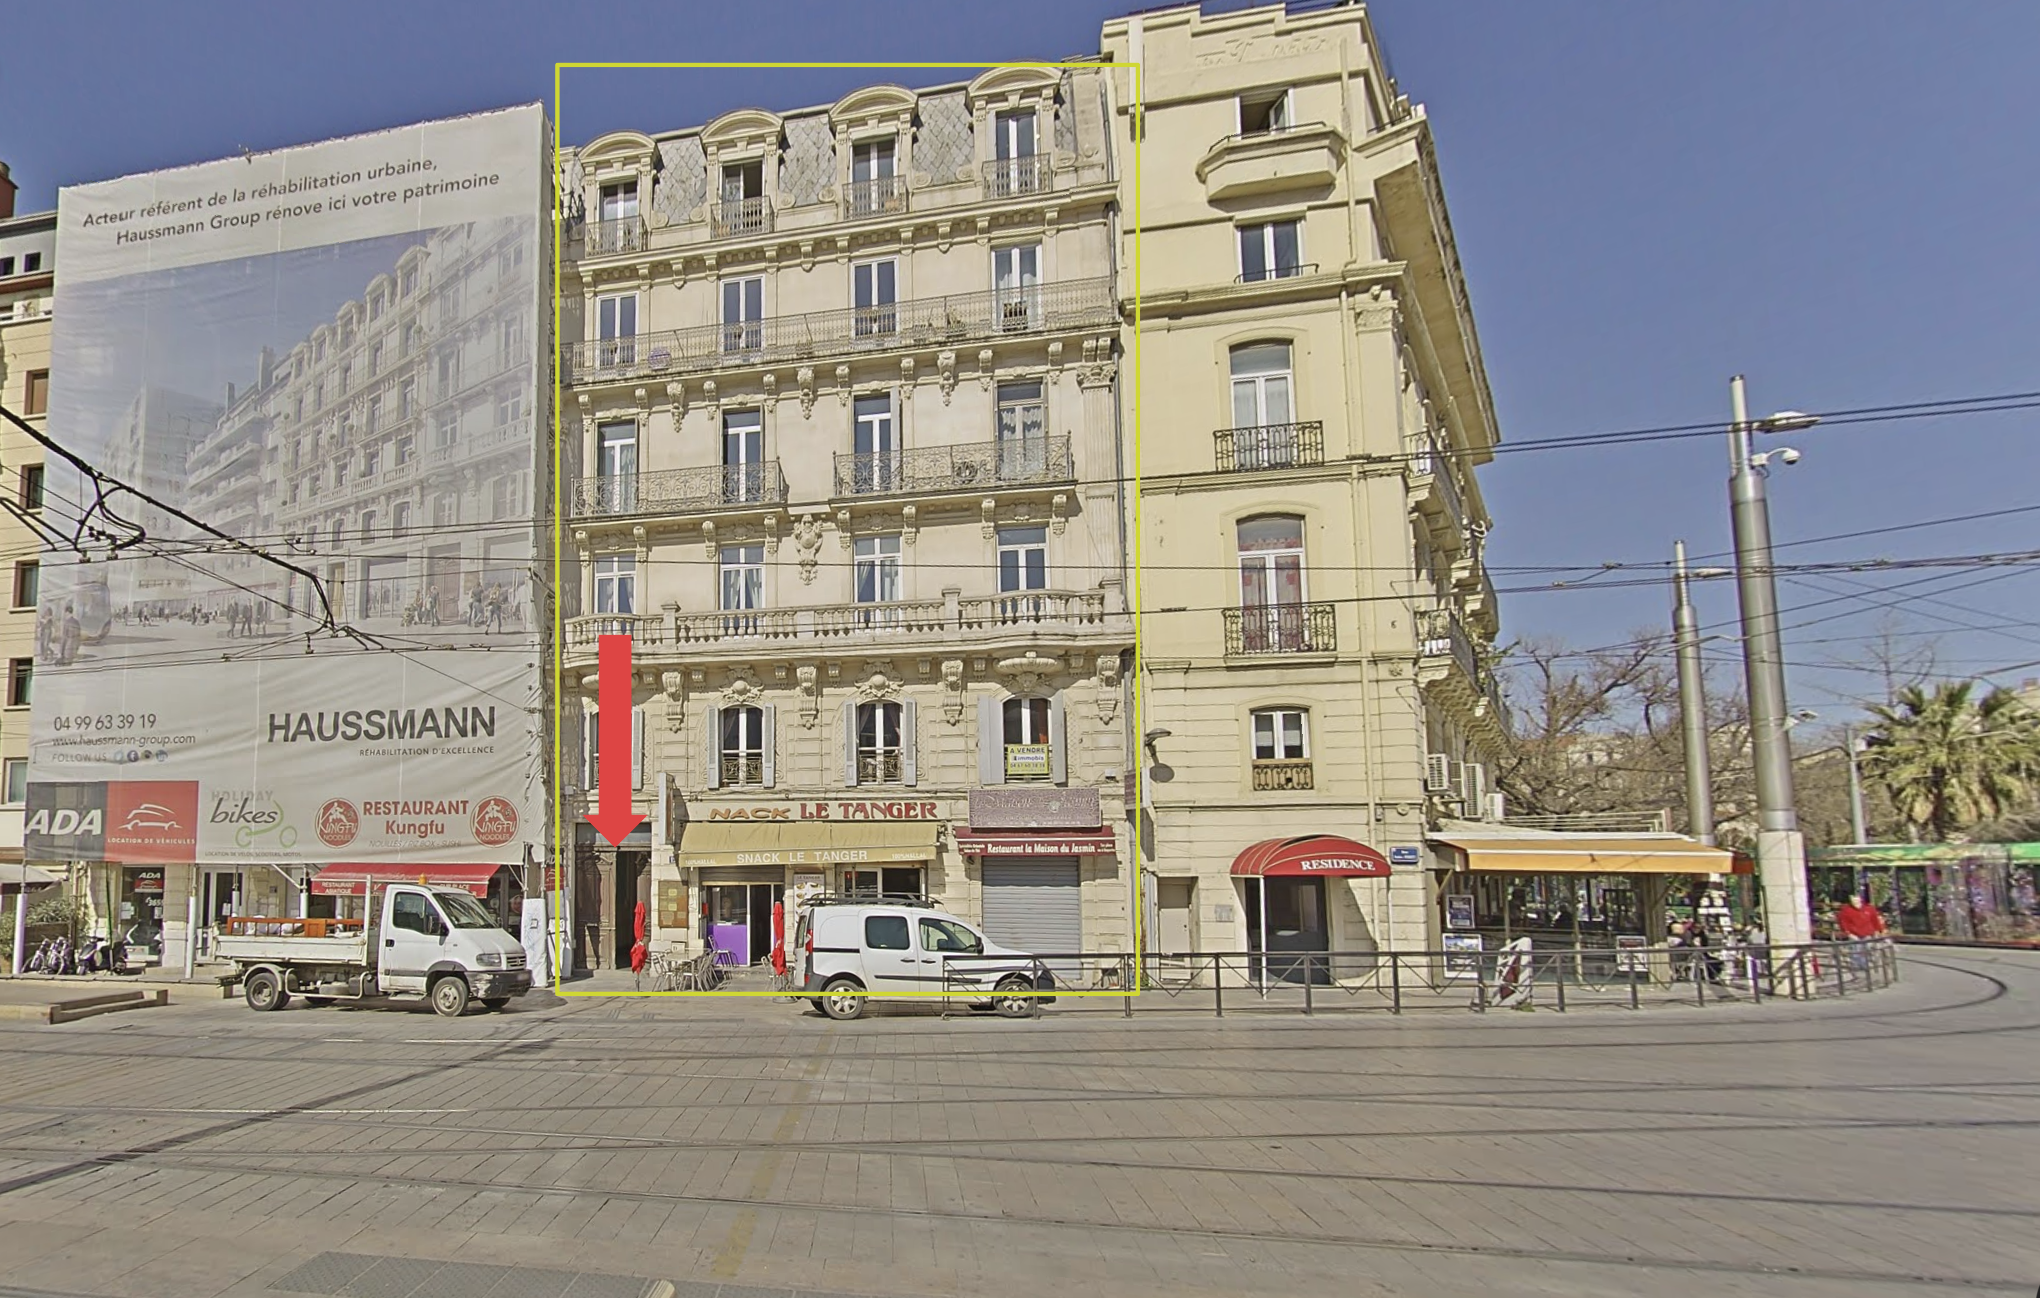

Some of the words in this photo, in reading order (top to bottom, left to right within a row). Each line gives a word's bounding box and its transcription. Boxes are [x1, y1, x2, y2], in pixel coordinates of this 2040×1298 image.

[83, 209, 136, 227] Acteur
[140, 197, 203, 218] référent
[207, 192, 227, 207] de
[232, 188, 246, 203] la
[251, 171, 361, 200] réhabilitation
[367, 158, 437, 180] urbaine,
[116, 221, 204, 245] Haussmann
[210, 212, 260, 229] Group
[266, 202, 322, 220] rénove
[328, 194, 346, 211] ici
[352, 189, 397, 208] votre
[402, 173, 500, 203] patrimoine
[54, 716, 71, 731] 04
[74, 715, 92, 730] 99
[95, 714, 113, 730] 63
[117, 714, 135, 729] 39
[140, 713, 157, 729] 19
[267, 705, 496, 743] HAUSSMANN
[51, 734, 196, 748] www.haussmann-group.com
[52, 753, 91, 763] FOLLOW
[96, 753, 107, 762] US
[359, 746, 429, 757] RÉHABILITATION
[432, 746, 494, 755] D'EXCELLENCE
[211, 790, 273, 801] HOLIDAY
[210, 796, 279, 824] bikes
[363, 800, 469, 816] RESTAURANT
[709, 807, 791, 820] NACK
[800, 802, 830, 819] LE
[838, 802, 938, 819] TANGER
[25, 808, 103, 836] ADA
[385, 819, 445, 839] Kungfu
[107, 837, 142, 845] LOCATION
[156, 837, 196, 845] VÉHICULES
[987, 843, 1024, 853] Restaurant
[1025, 843, 1033, 853] la
[1033, 843, 1059, 853] Maison
[1060, 843, 1070, 853] du
[1071, 843, 1096, 853] Jasmin
[736, 852, 780, 864] SNACK
[789, 852, 805, 862] LE
[815, 850, 868, 862] TANGER
[1301, 859, 1376, 871] RESIDENCE
